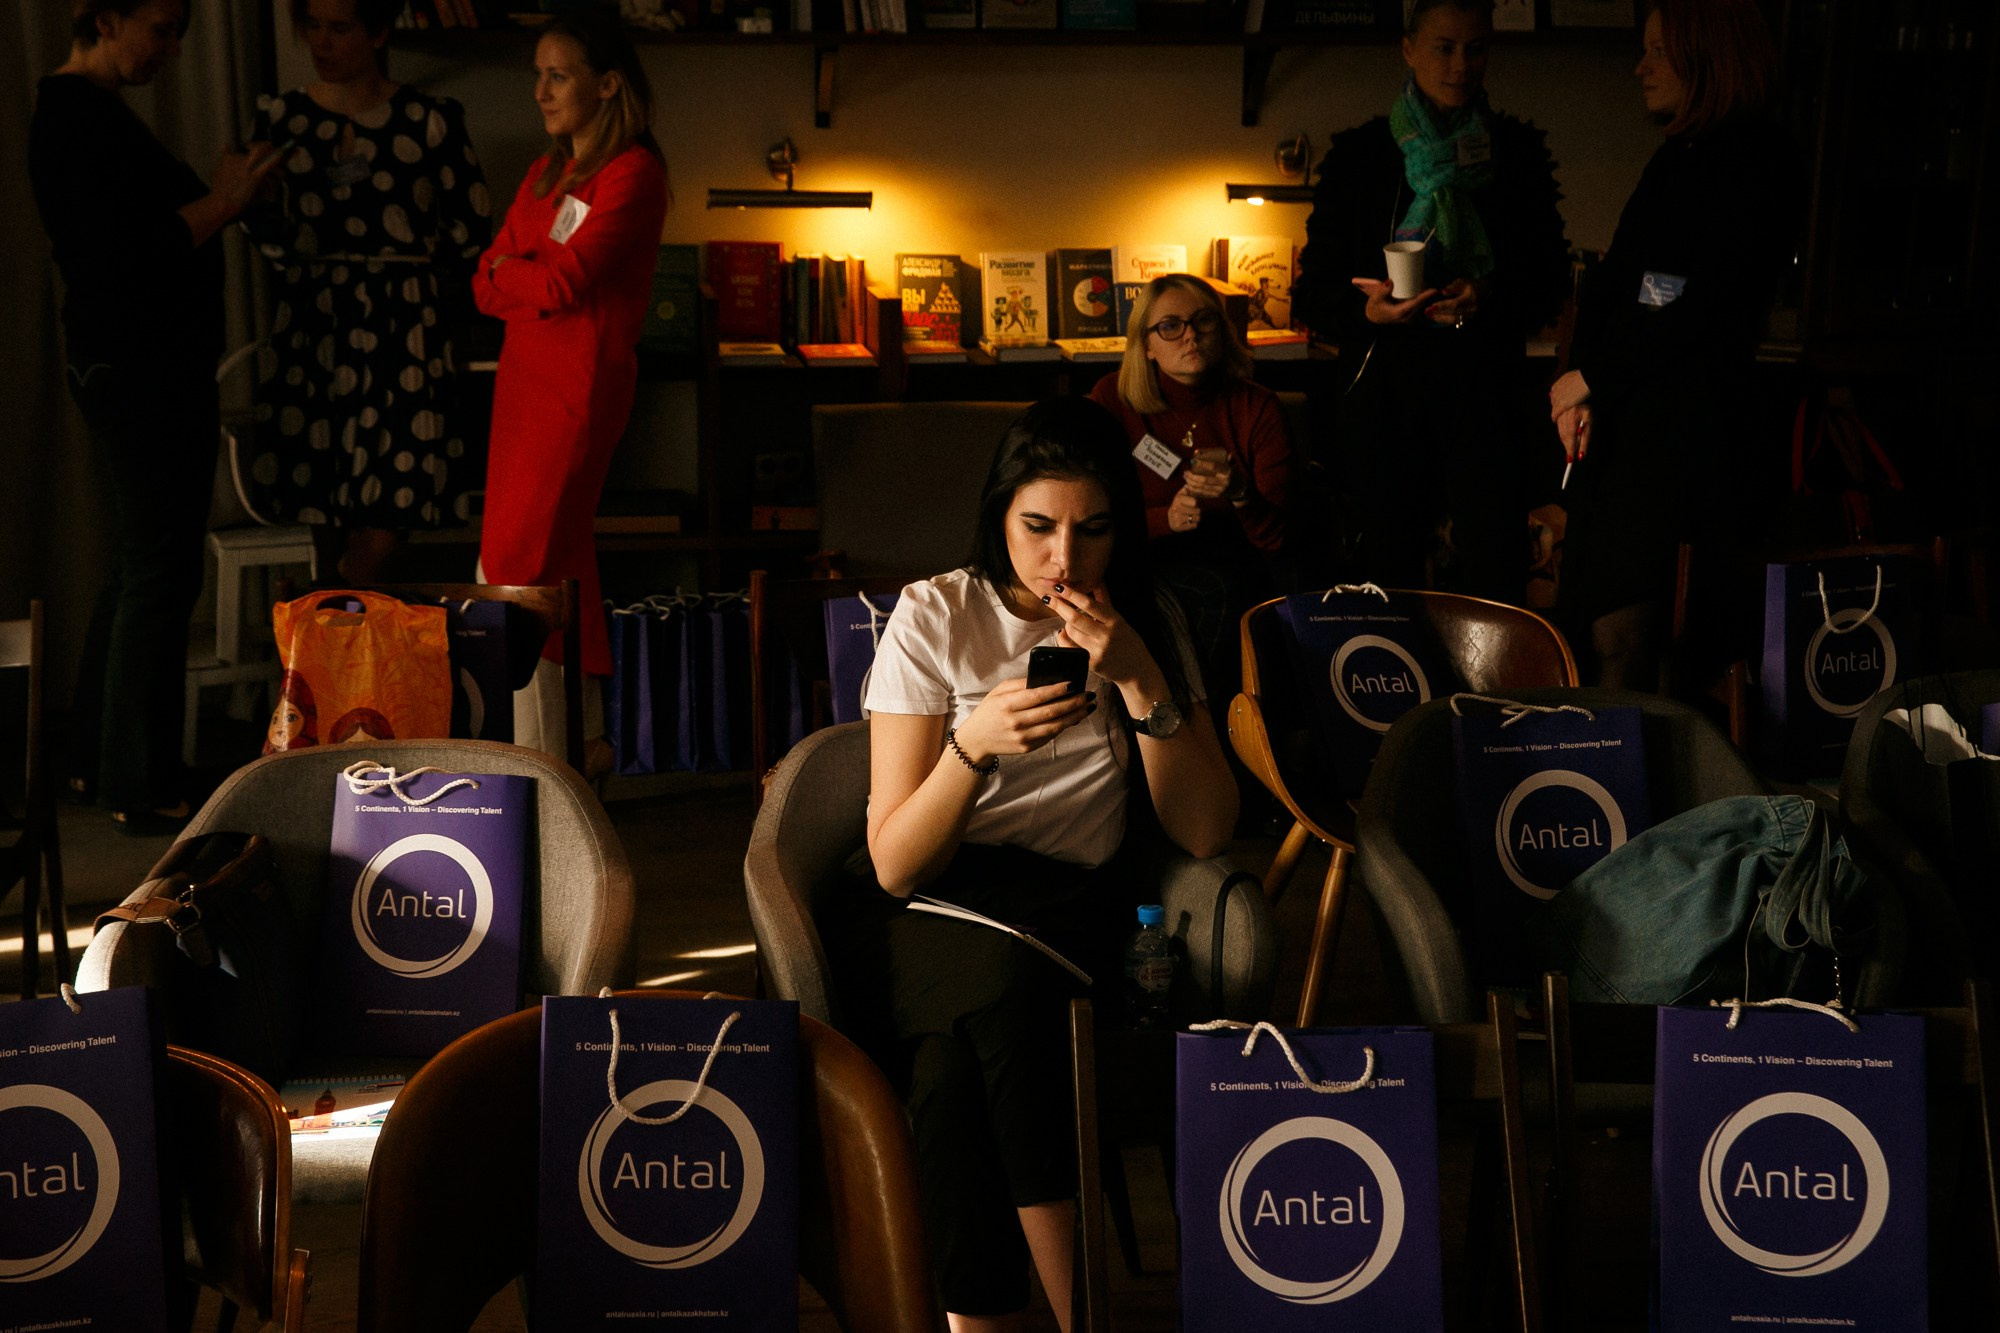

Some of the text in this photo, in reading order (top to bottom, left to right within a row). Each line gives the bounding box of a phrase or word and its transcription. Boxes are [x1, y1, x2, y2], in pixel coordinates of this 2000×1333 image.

[1822, 646, 1880, 675] Antal
[1352, 671, 1415, 694] Antal
[1530, 743, 1553, 751] Vision
[1560, 740, 1600, 749] Discovering
[1600, 739, 1622, 747] Talent
[361, 805, 401, 813] Continents,
[437, 807, 479, 815] Discovering
[480, 807, 502, 815] Talent
[1519, 818, 1603, 850] Antal
[376, 888, 466, 918] Antal
[29, 1040, 86, 1054] Discovering
[87, 1035, 117, 1046] Talent
[576, 1042, 581, 1050] 5
[584, 1042, 638, 1052] Contints,
[641, 1043, 645, 1051] 1
[648, 1043, 677, 1052] Vision
[687, 1043, 741, 1054] Discoring
[742, 1043, 770, 1053] Talent
[1693, 1054, 1699, 1062] 5
[1701, 1054, 1756, 1064] Continents,
[1765, 1056, 1795, 1065] Vision
[1805, 1057, 1862, 1068] Discovering
[1864, 1059, 1894, 1067] Talent
[1210, 1083, 1216, 1091] 5
[1218, 1082, 1272, 1091] Continents,
[1377, 1078, 1405, 1087] Talent
[612, 1151, 731, 1189] Antal
[1733, 1161, 1855, 1201] Antal
[1253, 1186, 1371, 1226] Antal
